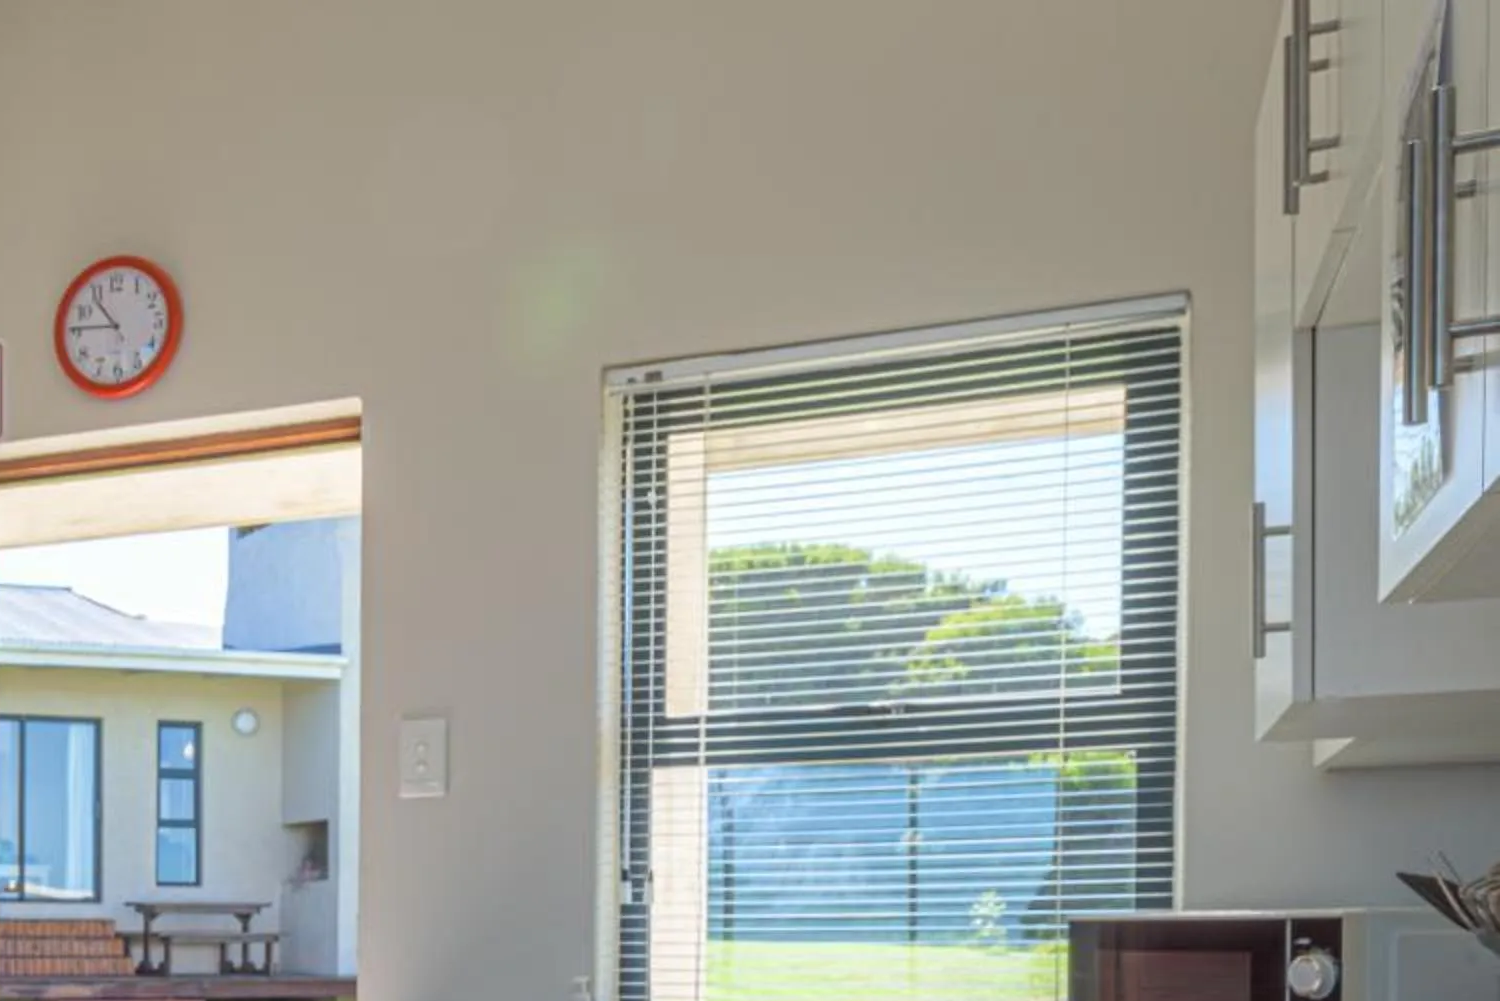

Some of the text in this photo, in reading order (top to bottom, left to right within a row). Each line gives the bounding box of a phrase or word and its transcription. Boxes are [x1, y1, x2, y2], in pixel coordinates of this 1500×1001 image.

[109, 273, 124, 293] 12
[147, 291, 158, 310] 2
[153, 310, 164, 330] 3
